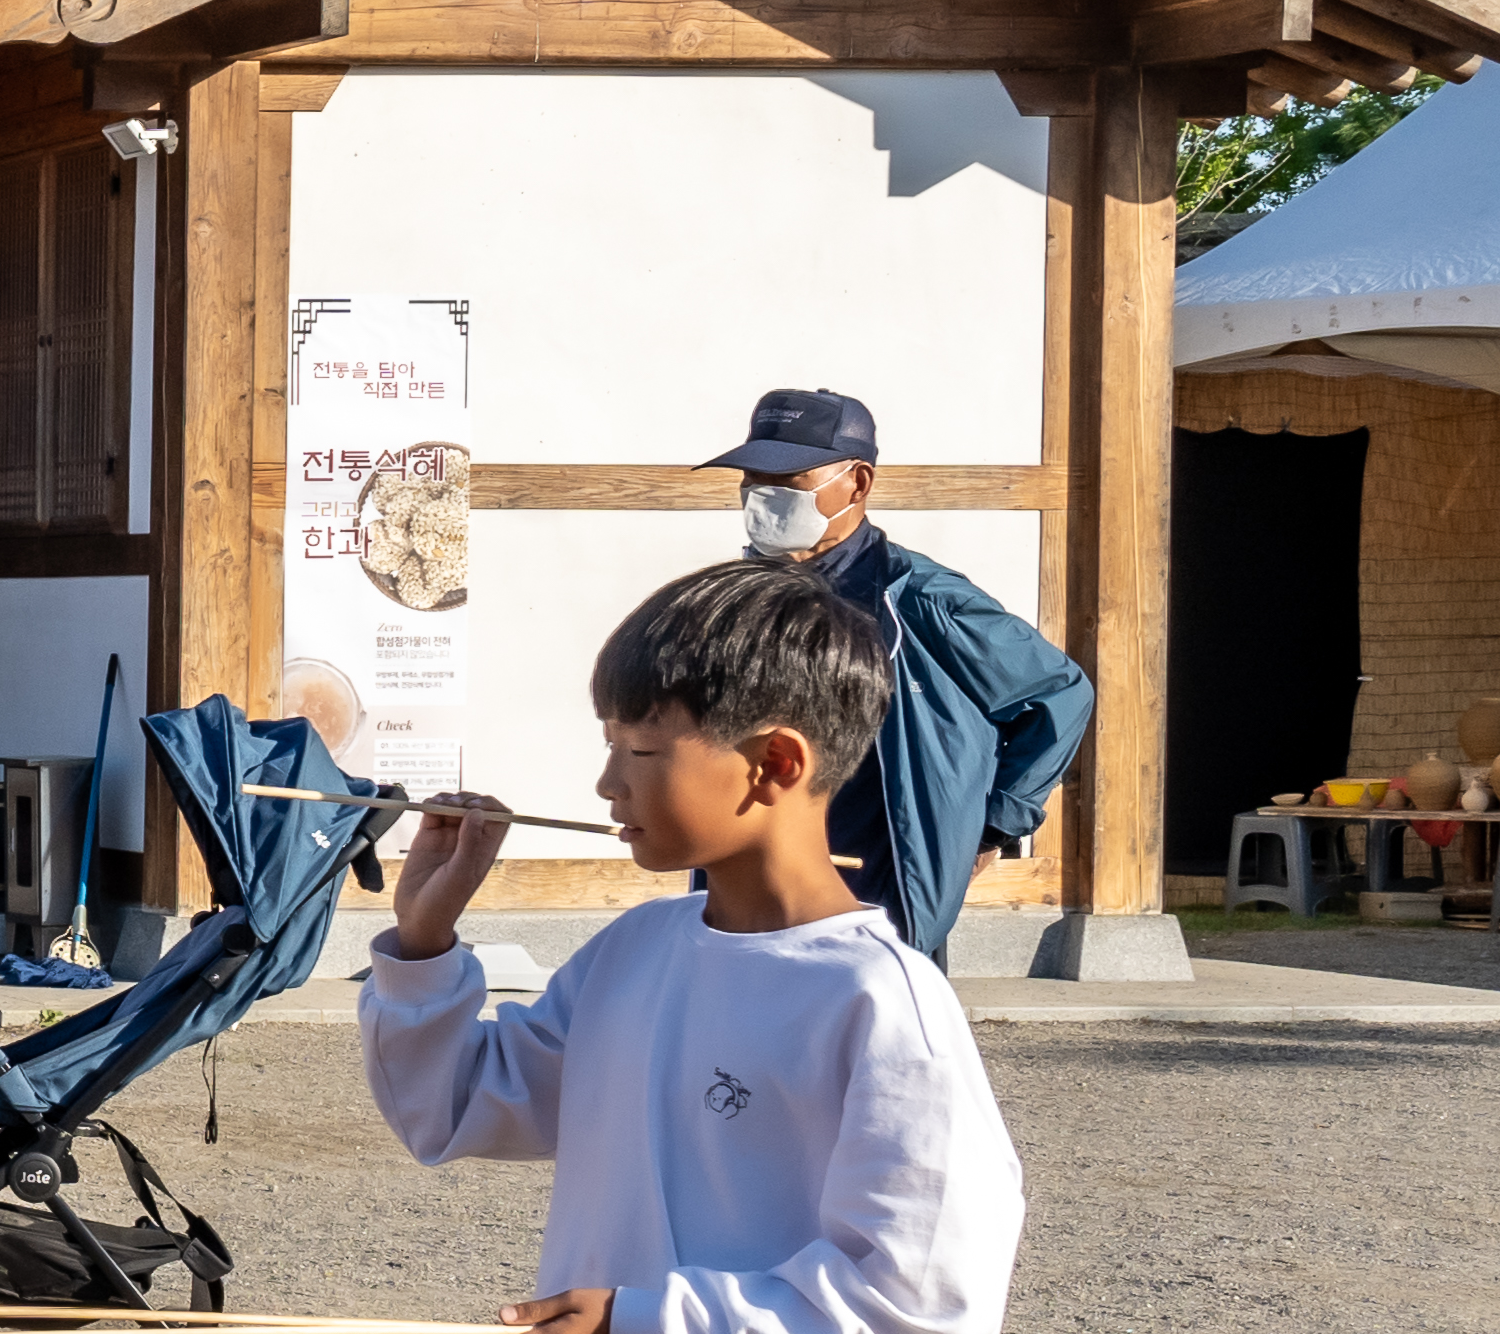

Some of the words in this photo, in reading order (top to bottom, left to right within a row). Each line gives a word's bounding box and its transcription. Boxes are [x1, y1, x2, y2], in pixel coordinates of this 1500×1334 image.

[312, 361, 369, 379] 전통을
[378, 361, 416, 379] 담아
[363, 381, 398, 399] 직접
[408, 382, 445, 399] 만든
[302, 448, 445, 482] 전통식혜
[301, 500, 358, 518] 그리고
[301, 526, 373, 559] 한과
[377, 623, 403, 632] Zero
[376, 636, 431, 648] 합성첨가물이
[433, 636, 451, 647] 전혀
[376, 720, 413, 732] Check
[20, 1169, 51, 1185] Joie
